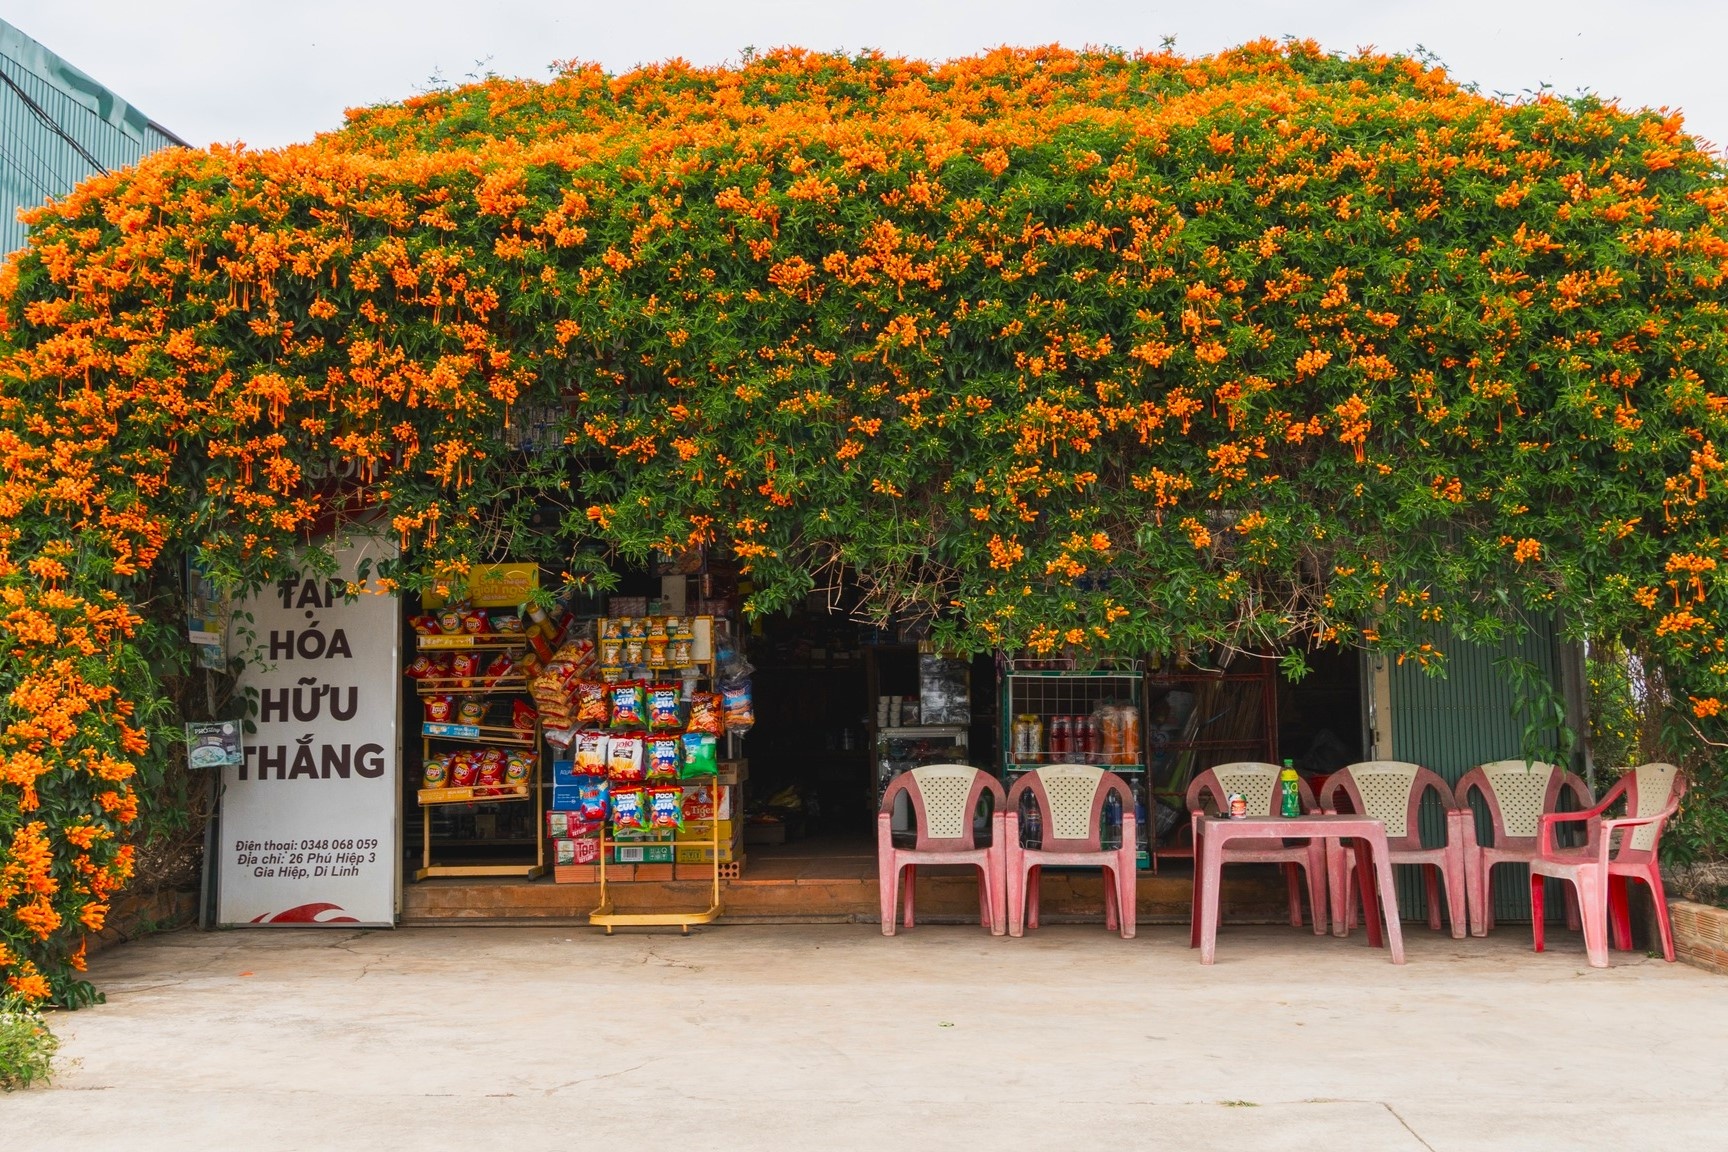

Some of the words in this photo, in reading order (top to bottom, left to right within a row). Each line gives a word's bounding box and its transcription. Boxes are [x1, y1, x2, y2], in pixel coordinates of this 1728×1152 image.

[277, 578, 347, 619] TẠP
[269, 620, 353, 660] HÓA
[261, 677, 358, 722] HỮU
[238, 733, 385, 780] THẮNG
[655, 750, 675, 758] CUA
[616, 802, 636, 811] CUA
[655, 802, 674, 810] CUA
[236, 840, 261, 854] Điện
[264, 840, 298, 854] thoại:
[301, 839, 329, 850] 0348
[331, 839, 353, 850] 068
[356, 839, 378, 850] 059
[237, 854, 258, 867] Địa
[261, 853, 285, 865] chỉ:
[289, 853, 303, 864] 26
[307, 852, 332, 864] Phú
[335, 852, 364, 866] Hiệp
[368, 853, 376, 863] 3
[253, 866, 274, 877] Gia
[278, 866, 310, 879] Hiệp,
[314, 866, 328, 877] Di
[331, 865, 359, 877] Linh
